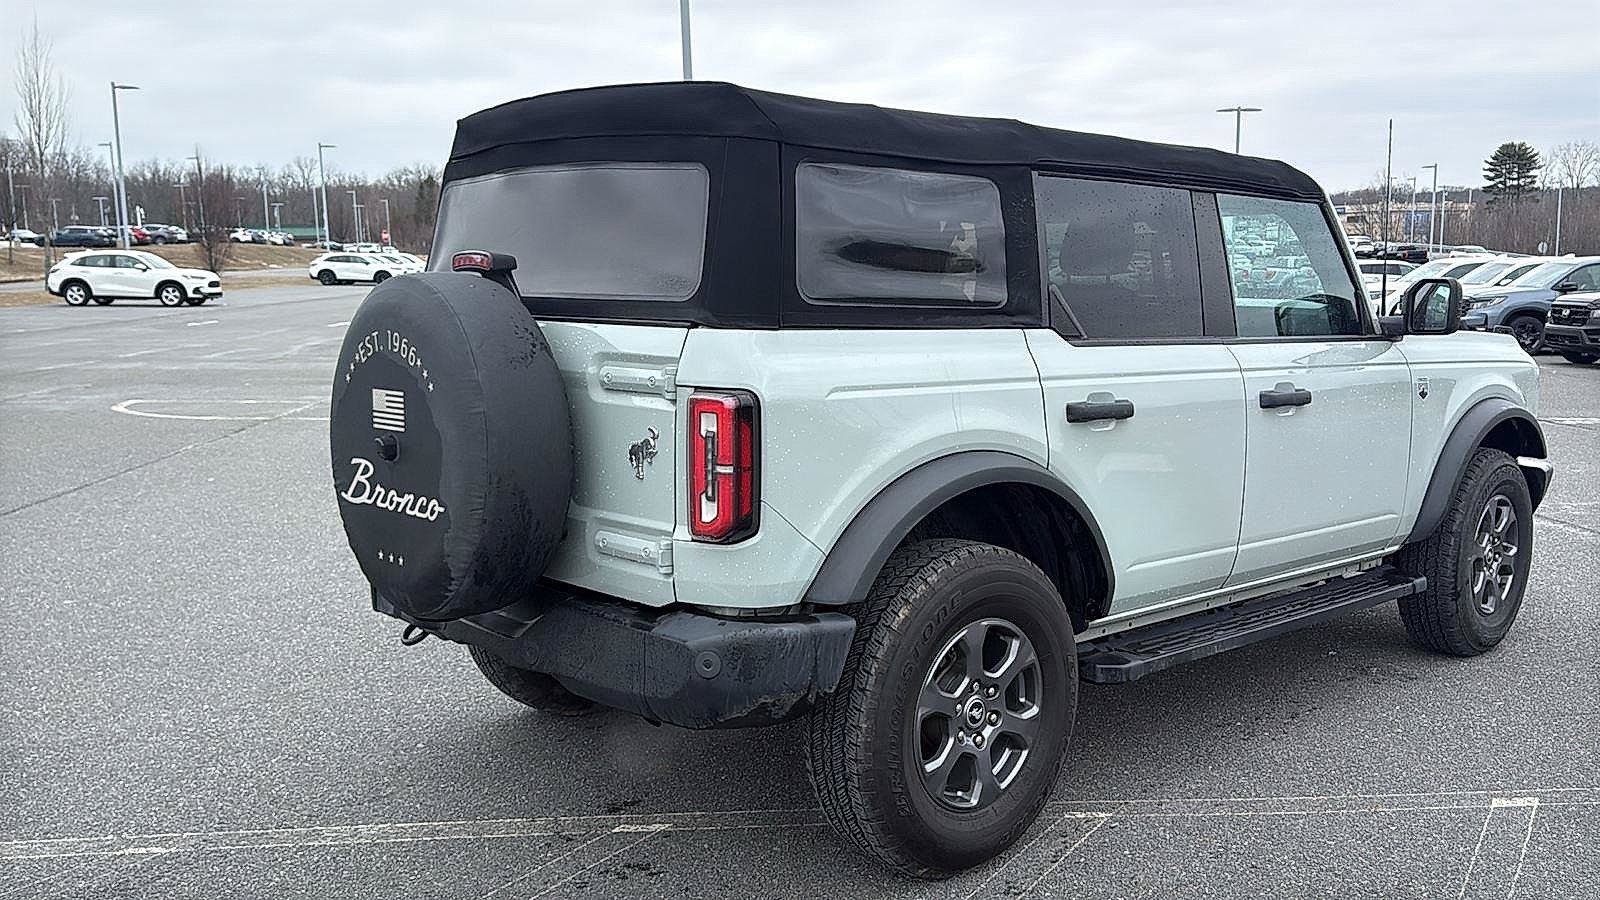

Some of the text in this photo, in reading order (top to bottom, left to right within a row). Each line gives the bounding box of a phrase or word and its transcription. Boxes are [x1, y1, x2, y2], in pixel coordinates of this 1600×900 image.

[358, 330, 417, 366] EST. 1966
[340, 457, 445, 521] Bronco
